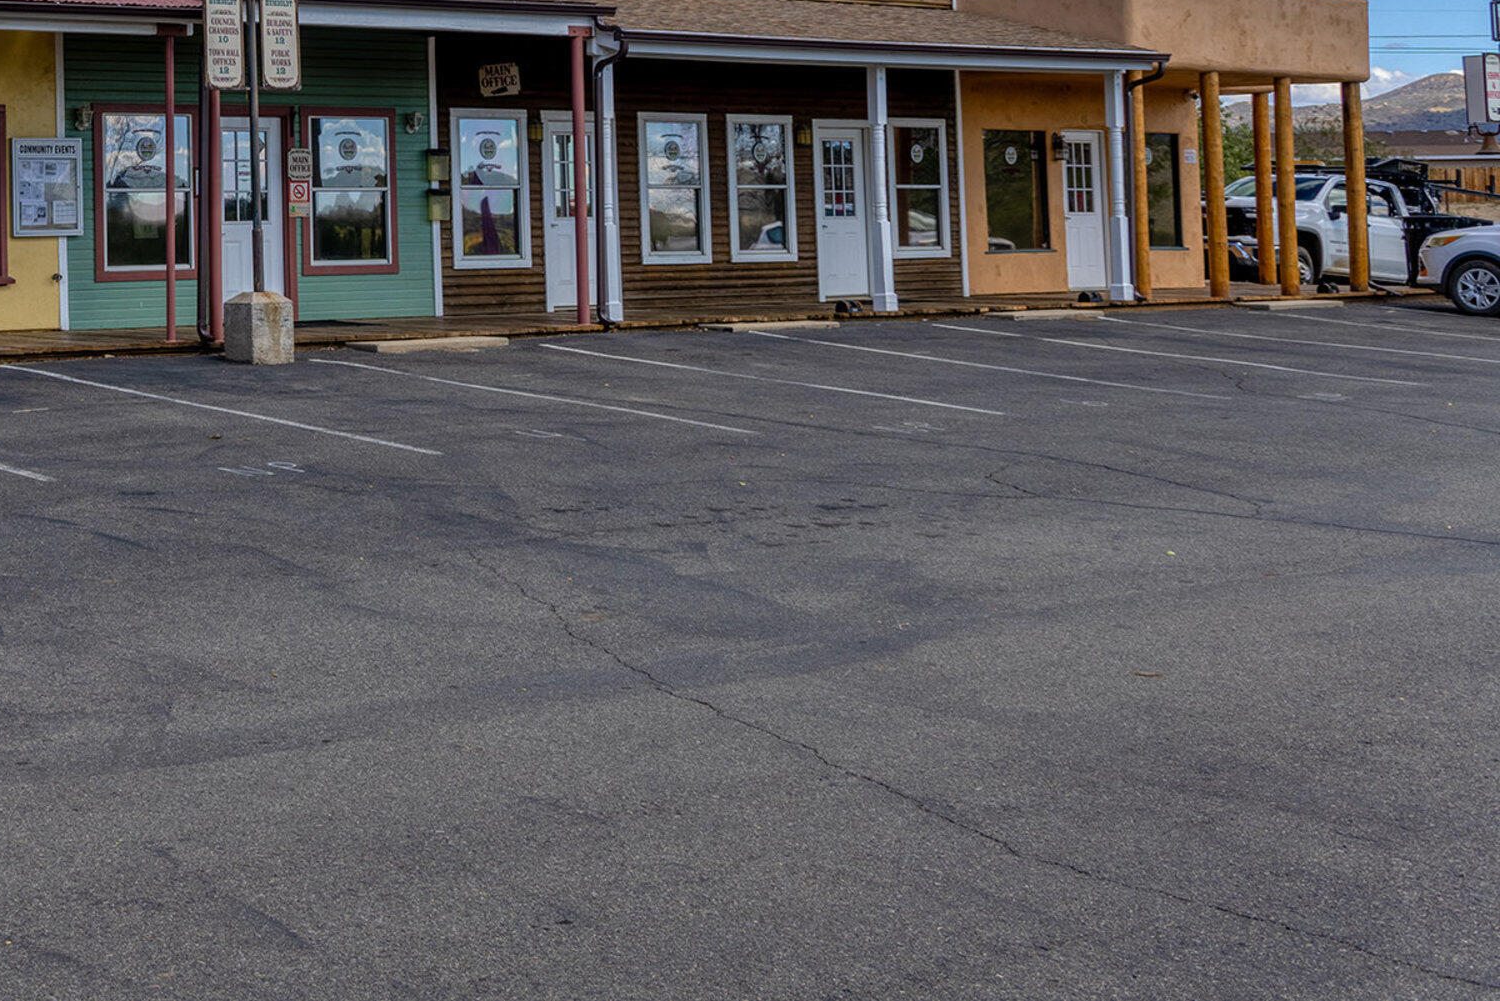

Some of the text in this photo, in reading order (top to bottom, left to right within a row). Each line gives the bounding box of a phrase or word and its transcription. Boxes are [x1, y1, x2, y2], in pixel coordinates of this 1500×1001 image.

[210, 17, 236, 26] COUNCIL
[208, 27, 240, 36] CHAMBERS
[275, 37, 286, 45] 12
[212, 58, 237, 66] OFFICES
[276, 67, 287, 75] 12
[484, 64, 511, 78] MAIN
[481, 74, 518, 88] OFFICE
[20, 144, 77, 154] COMMUNITY EVENTS
[290, 164, 310, 172] OFFICE
